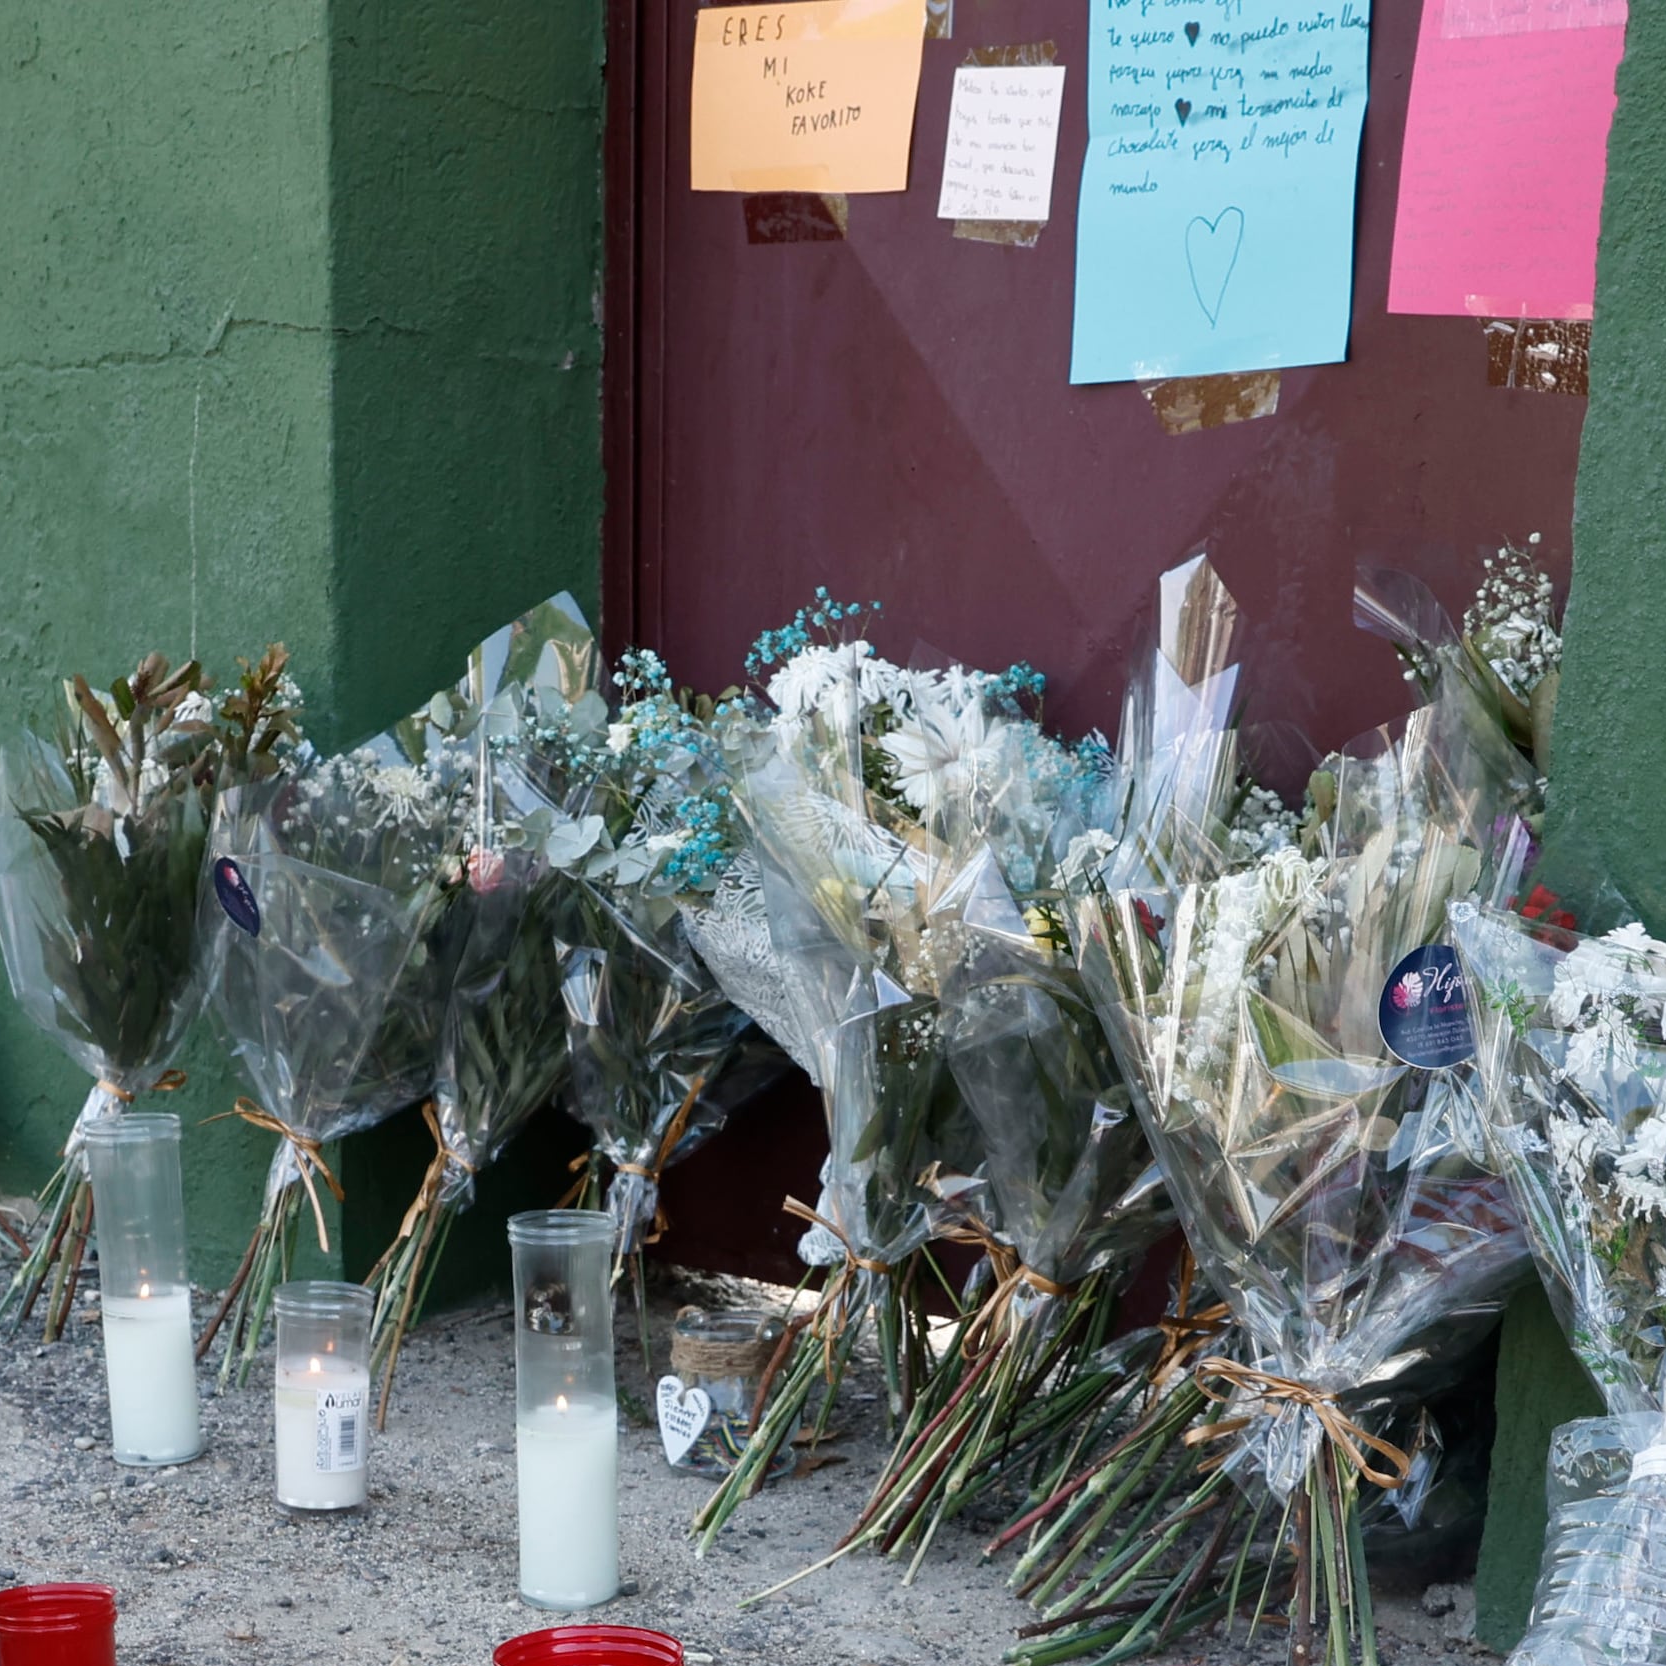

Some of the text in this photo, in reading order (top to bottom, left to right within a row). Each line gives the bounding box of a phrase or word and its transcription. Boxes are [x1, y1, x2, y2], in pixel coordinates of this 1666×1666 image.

[722, 14, 786, 47] ERES
[1210, 32, 1231, 46] no
[763, 57, 788, 79] MI
[785, 80, 828, 107] KOKE
[791, 106, 862, 135] FAVORITO
[1240, 121, 1258, 150] el
